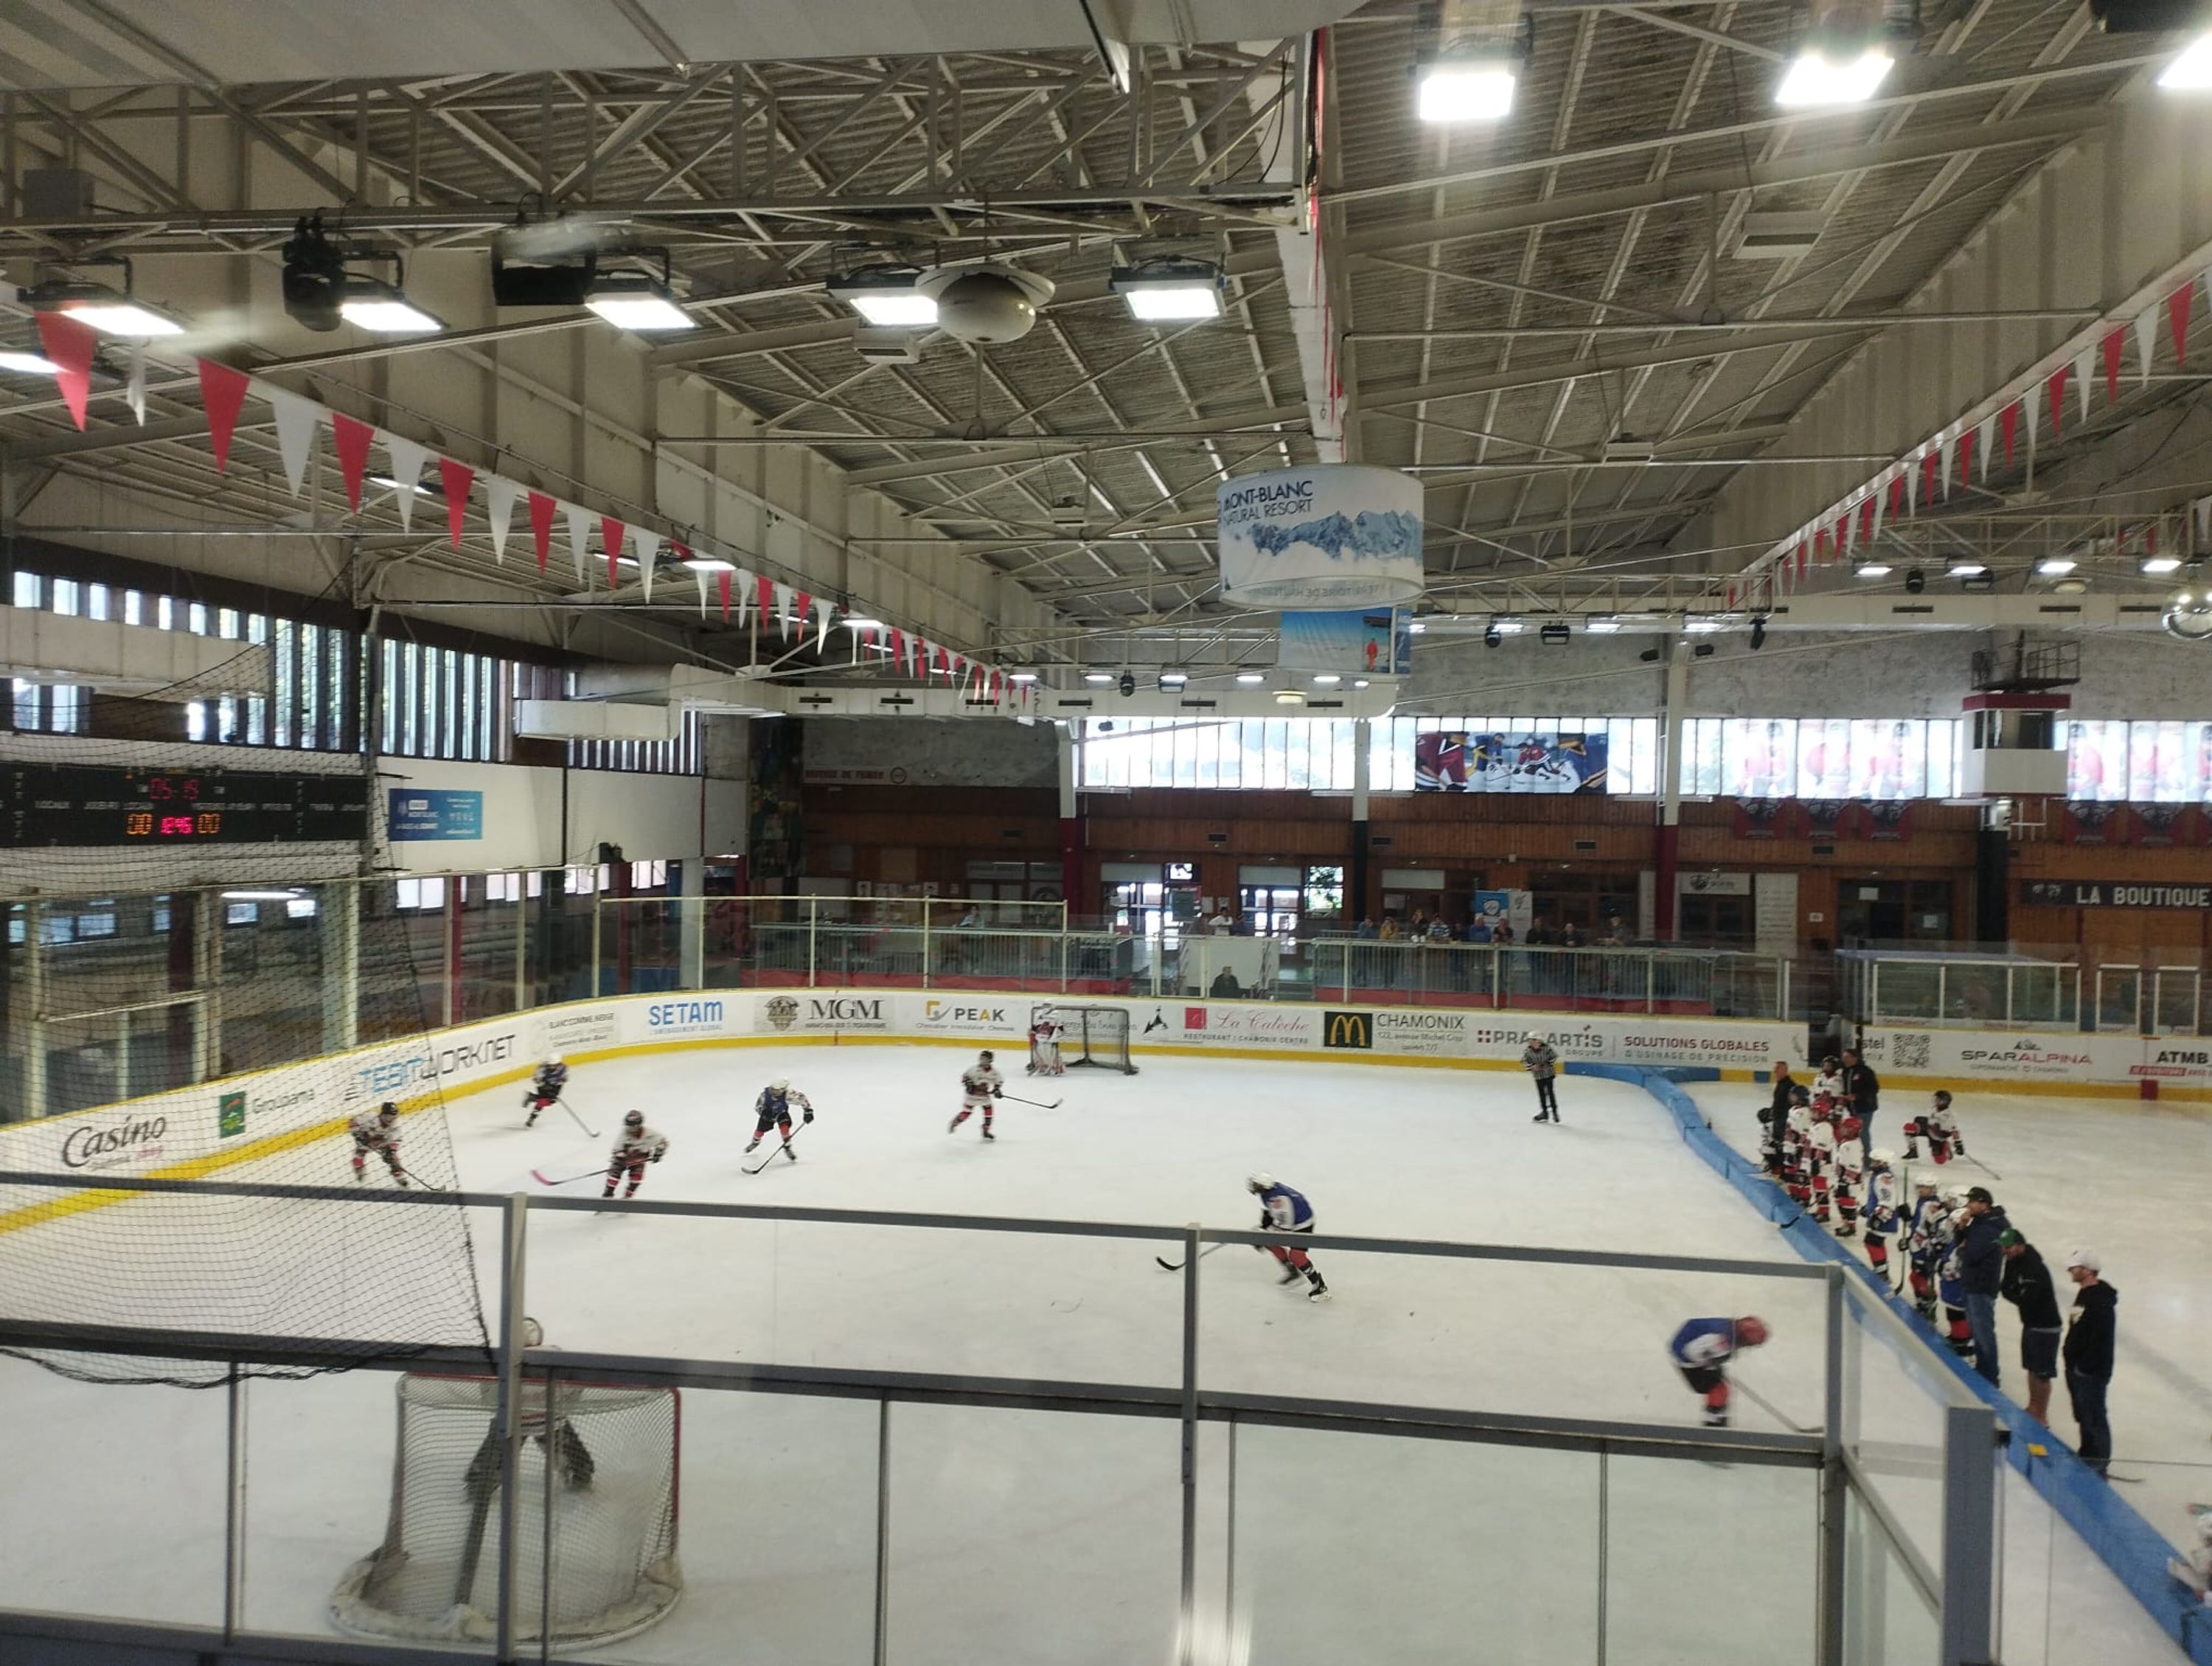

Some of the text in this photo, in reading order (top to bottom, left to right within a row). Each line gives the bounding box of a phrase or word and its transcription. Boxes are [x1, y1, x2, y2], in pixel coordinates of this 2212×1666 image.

[1223, 480, 1312, 511] MONT-BLANC
[1265, 499, 1313, 517] RESORT
[2076, 885, 2211, 907] LA BOUTIQUE
[649, 1000, 723, 1026] SETAM
[807, 998, 885, 1020] MGM
[954, 1007, 1006, 1022] PEAK
[1217, 1011, 1240, 1029] La
[1377, 1013, 1465, 1030] CHAMONIX
[1493, 1030, 1603, 1048] PRAARTIS
[1624, 1035, 1770, 1052] SOLUTIONS GLOBALES
[1565, 1049, 1603, 1058] GROUPE
[2157, 1050, 2209, 1065] ATMB
[61, 1115, 166, 1168] Casino
